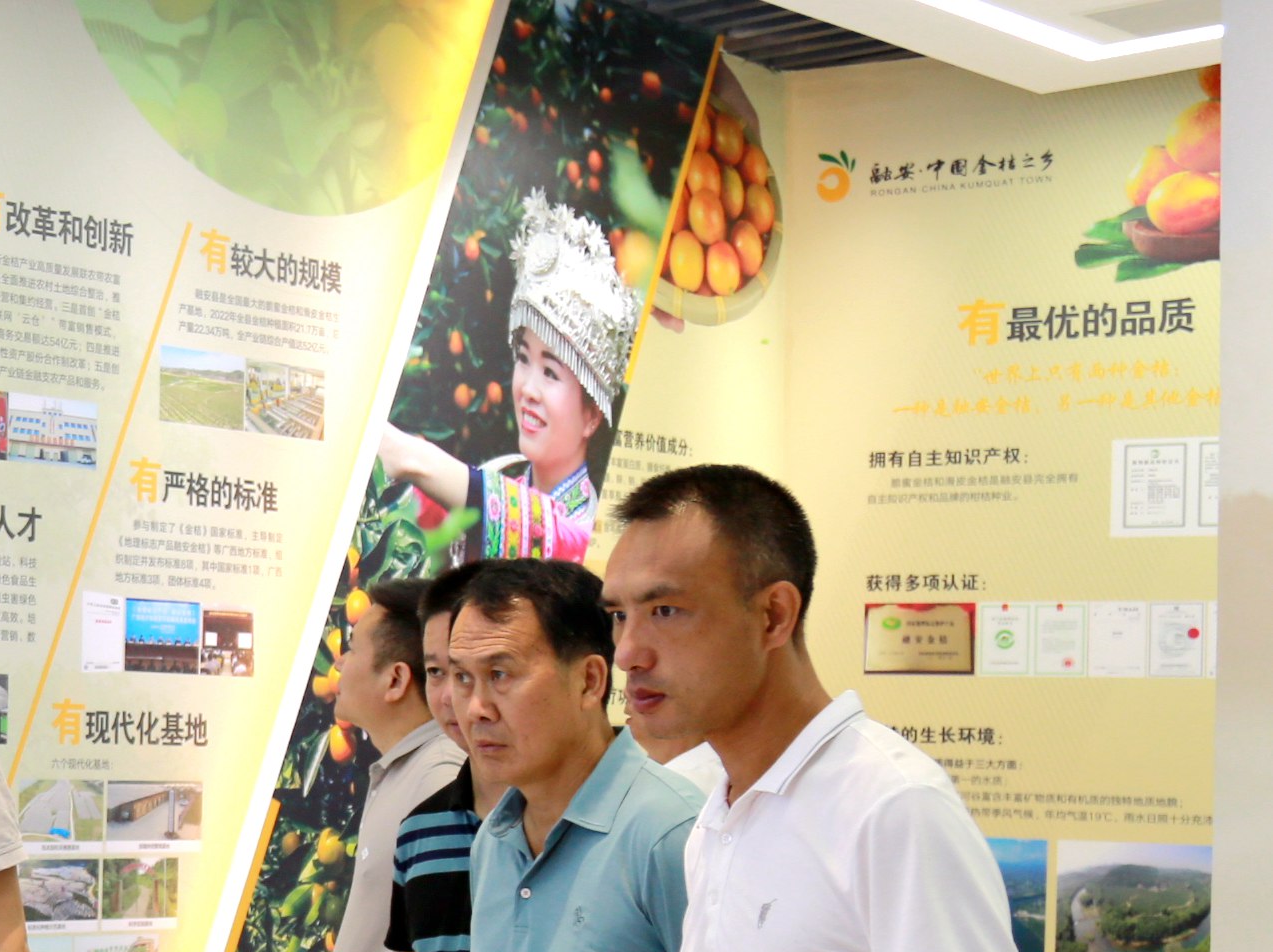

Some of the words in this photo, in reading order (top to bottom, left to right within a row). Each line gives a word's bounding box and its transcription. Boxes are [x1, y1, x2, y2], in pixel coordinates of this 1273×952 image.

[870, 186, 917, 197] RONGAN
[921, 183, 956, 194] CHINA
[960, 179, 1015, 190] KUMQUAT
[1019, 175, 1053, 185] TOWN
[200, 228, 342, 294] 有较大的规模
[958, 297, 1196, 347] 有最优的品质
[869, 447, 1029, 469] 拥有自主知识产权：
[130, 457, 278, 514] 有严格的标准
[51, 698, 209, 747] 有现代化基地
[890, 726, 1003, 746] 的生长环境：
